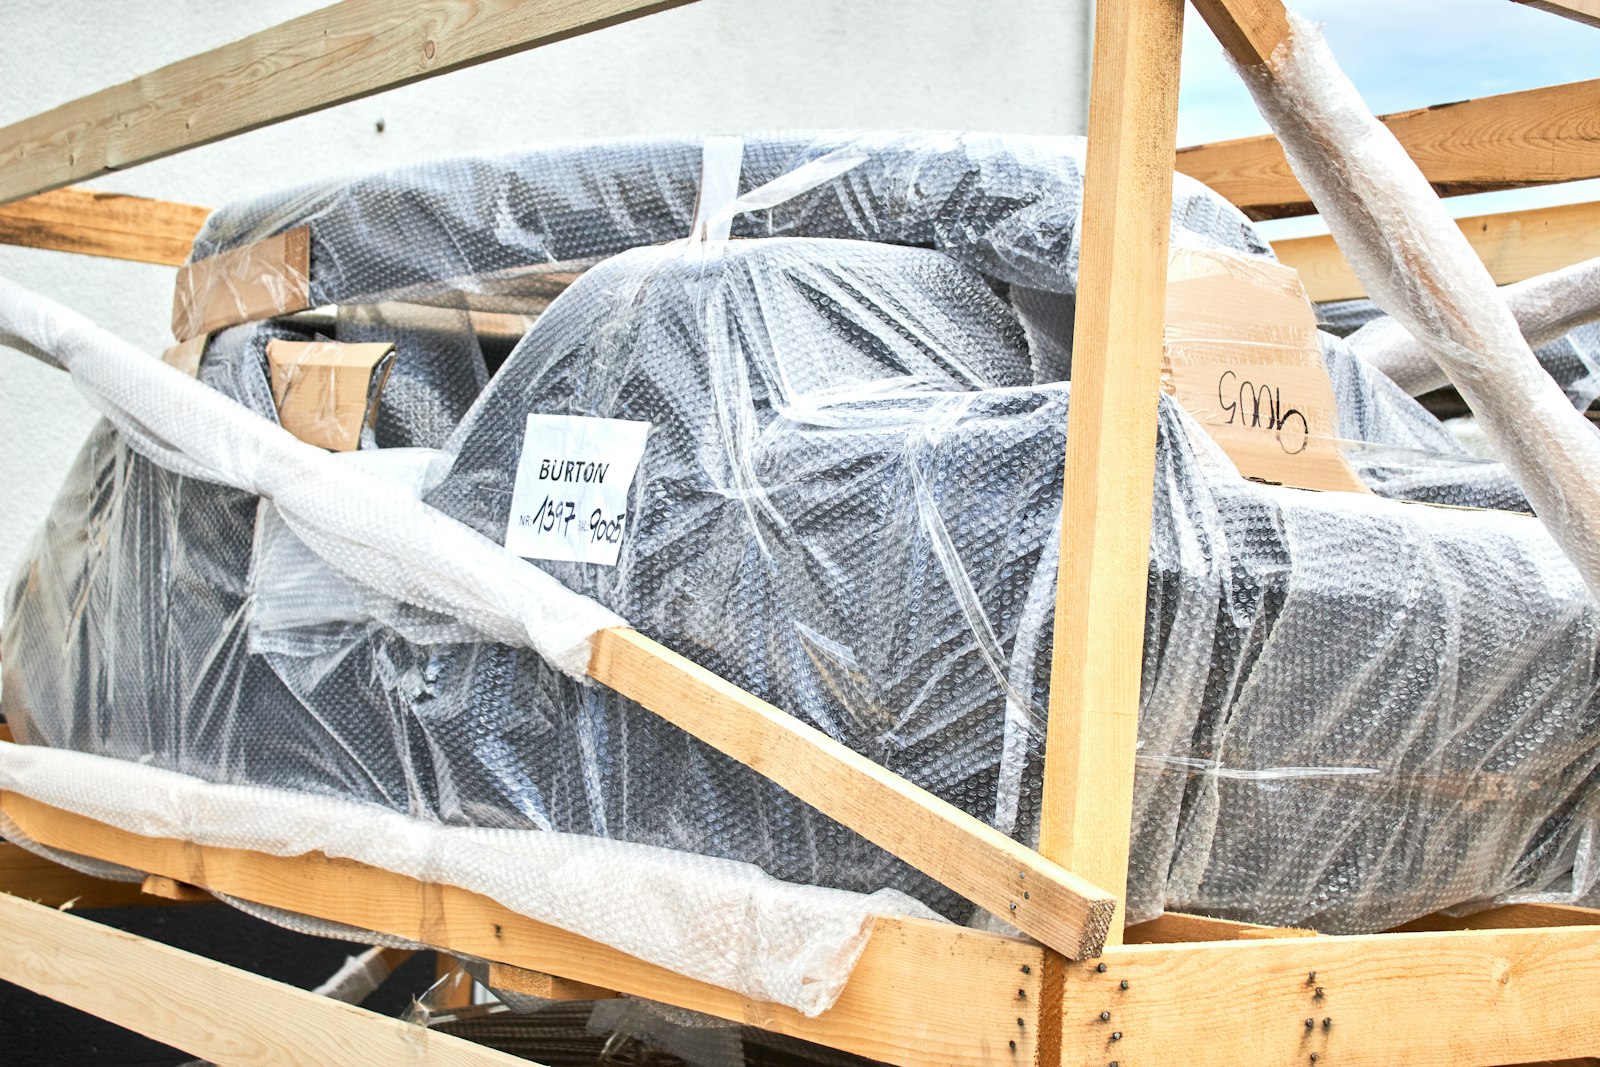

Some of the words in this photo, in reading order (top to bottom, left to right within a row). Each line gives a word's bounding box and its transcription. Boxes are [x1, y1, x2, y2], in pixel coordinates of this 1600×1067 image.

[539, 459, 610, 483] BURTON
[532, 494, 576, 537] 1397
[590, 508, 625, 544] 9005
